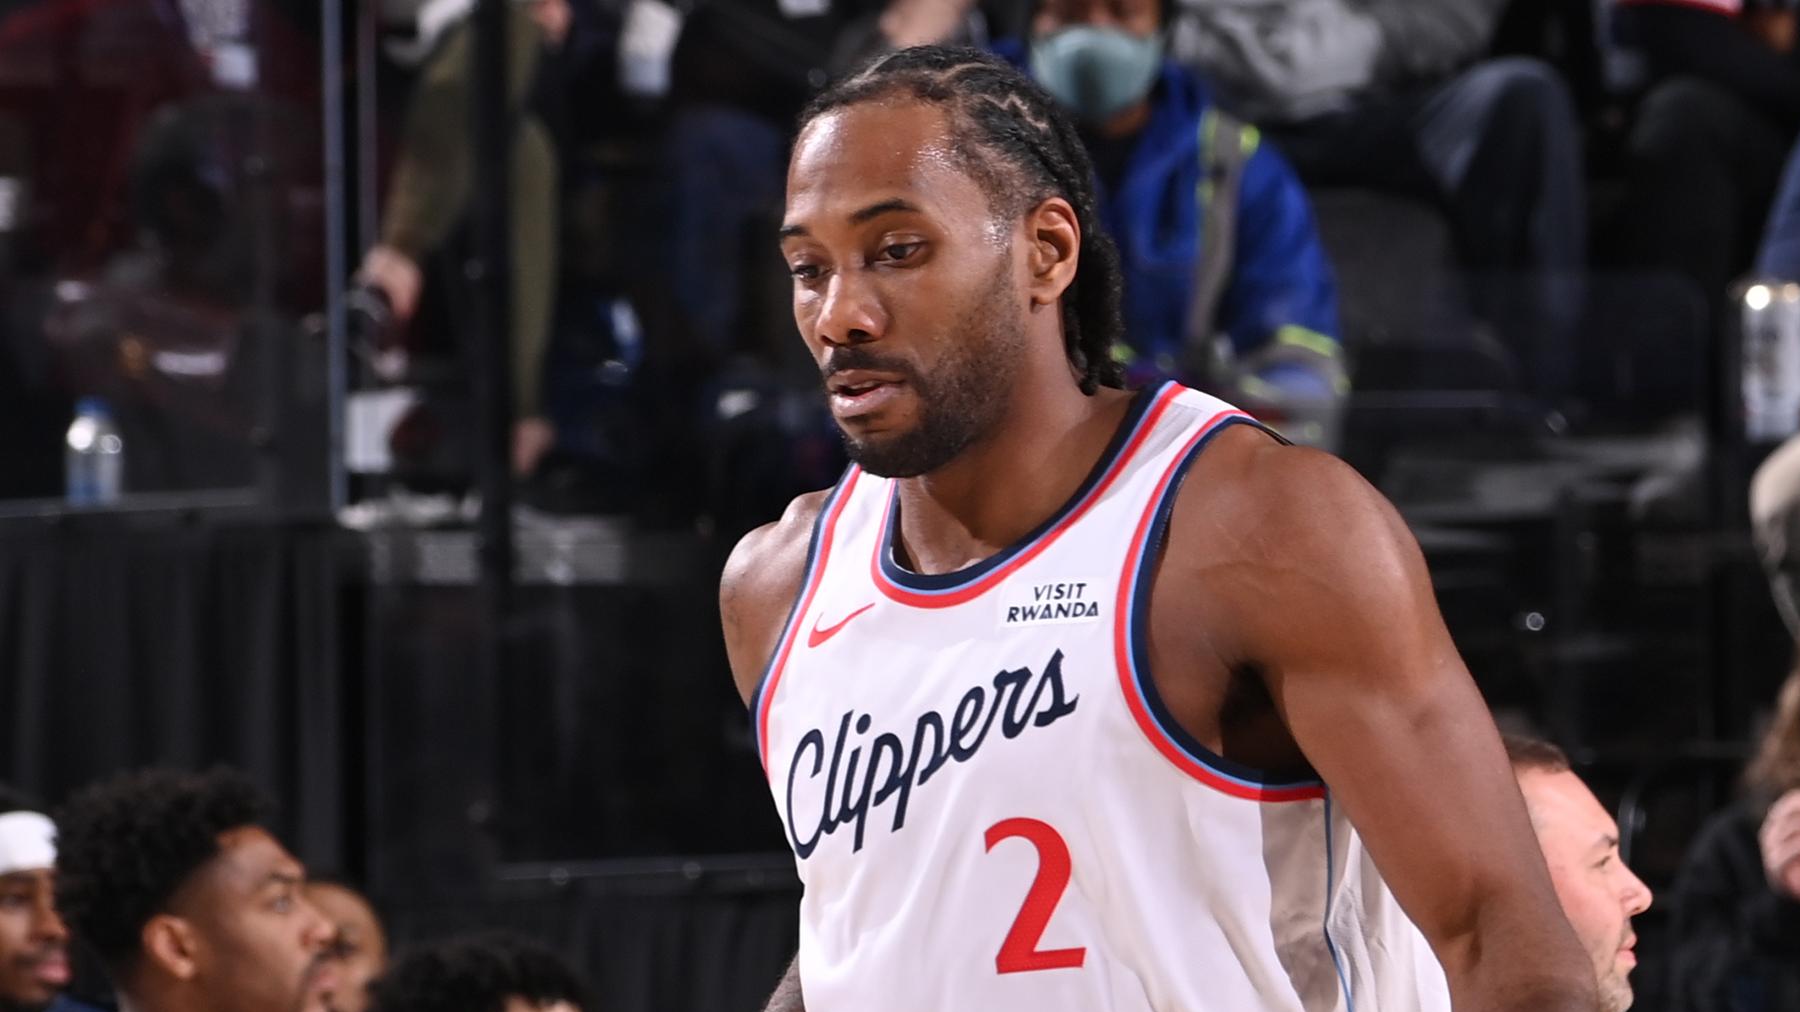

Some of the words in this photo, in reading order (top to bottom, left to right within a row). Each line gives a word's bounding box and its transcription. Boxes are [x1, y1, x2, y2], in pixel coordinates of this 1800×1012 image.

[1006, 601, 1099, 623] RWANDA
[1034, 583, 1087, 602] VISIT
[786, 648, 1080, 860] Clippers
[984, 817, 1087, 975] 2
